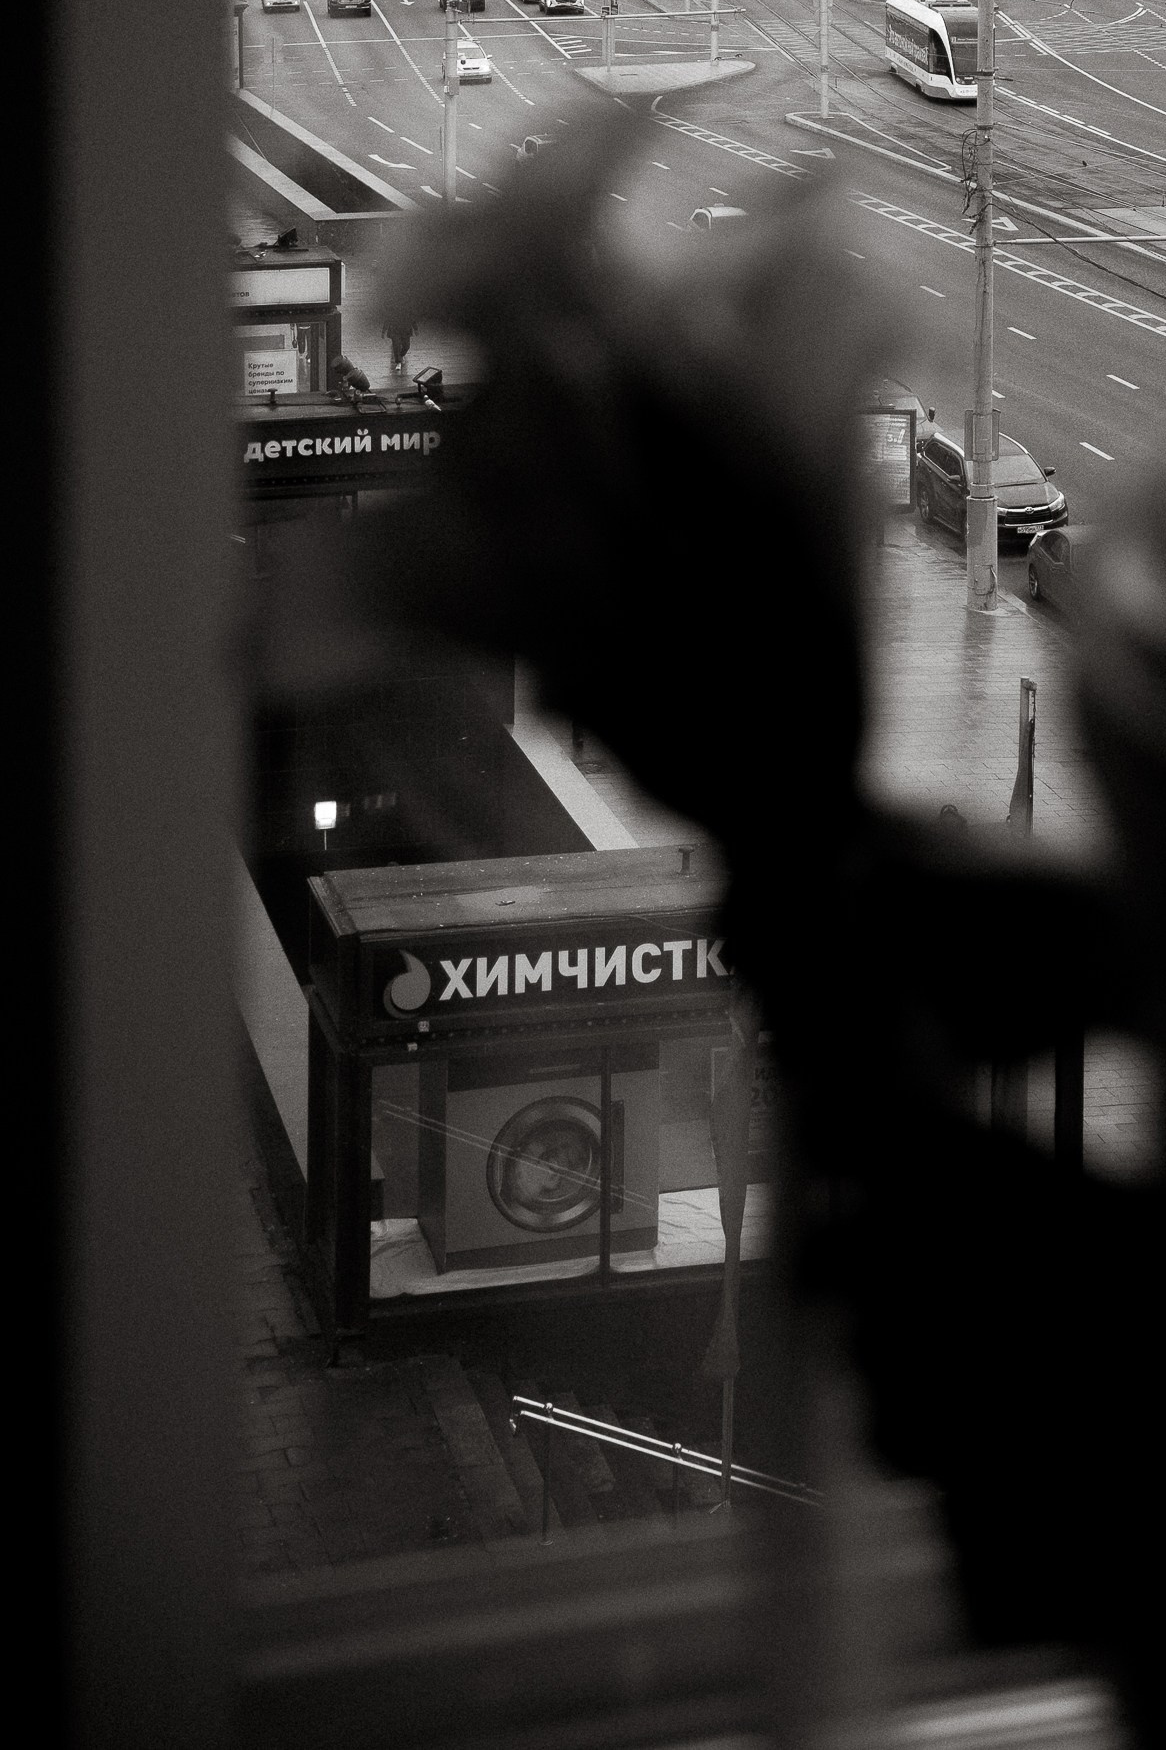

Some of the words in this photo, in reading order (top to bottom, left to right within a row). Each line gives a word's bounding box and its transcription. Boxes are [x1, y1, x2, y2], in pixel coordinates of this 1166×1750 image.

[248, 362, 274, 370] Крутые
[248, 370, 274, 378] бренды
[248, 377, 294, 387] супернизким
[244, 428, 372, 463] детский
[381, 431, 441, 456] мир
[438, 938, 736, 1001] ХИМЧИСТК
